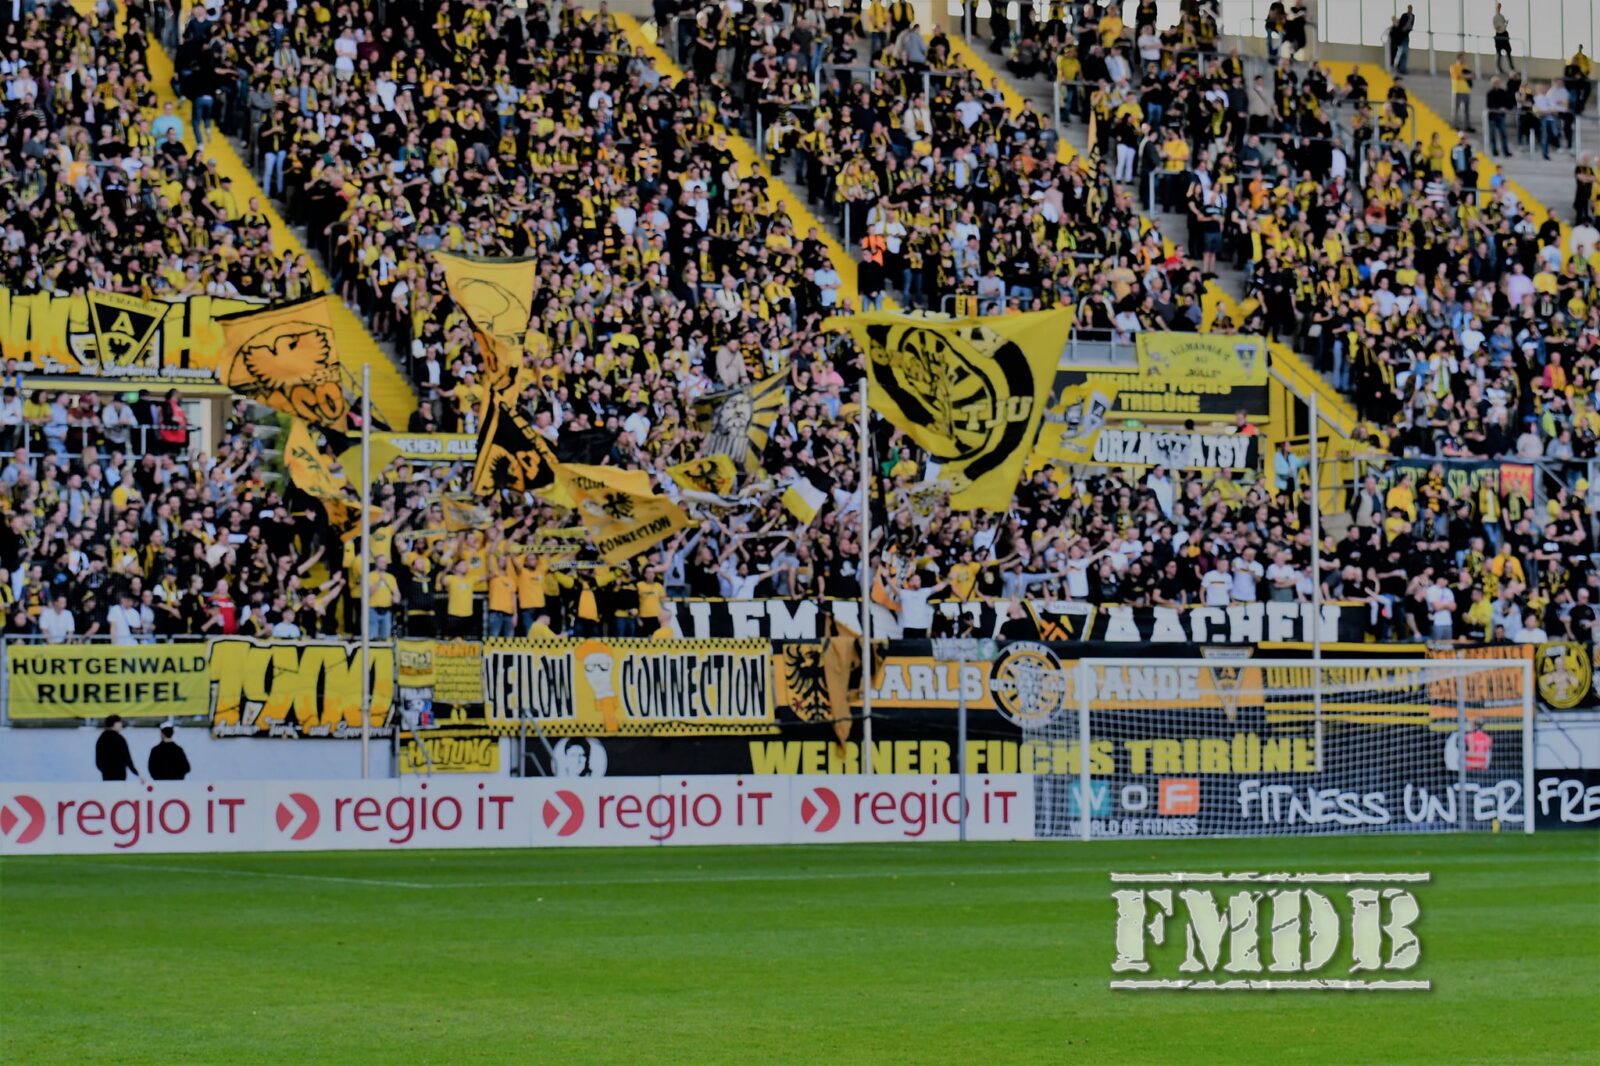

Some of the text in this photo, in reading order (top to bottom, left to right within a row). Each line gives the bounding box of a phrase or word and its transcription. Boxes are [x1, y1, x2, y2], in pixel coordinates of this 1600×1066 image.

[1119, 391, 1200, 412] TRIBÜNE
[599, 515, 671, 555] CONNECTION
[1103, 602, 1342, 643] AACHEN
[12, 654, 206, 676] HÜRTGENWALD
[486, 653, 574, 718] YELLOW
[622, 652, 766, 717] CONNECTION
[37, 682, 188, 704] RUREIFEL
[750, 732, 1316, 775] WERNER FUCHS TRIBÜNE
[58, 785, 245, 848] regio iT
[335, 782, 513, 844] regio iT
[599, 779, 772, 840] regio iT
[854, 779, 1017, 836] regio iT
[1238, 780, 1391, 825] FITNESS
[1403, 780, 1525, 824] UNTER
[1122, 819, 1140, 834] OF
[1143, 818, 1198, 834] FITNESS
